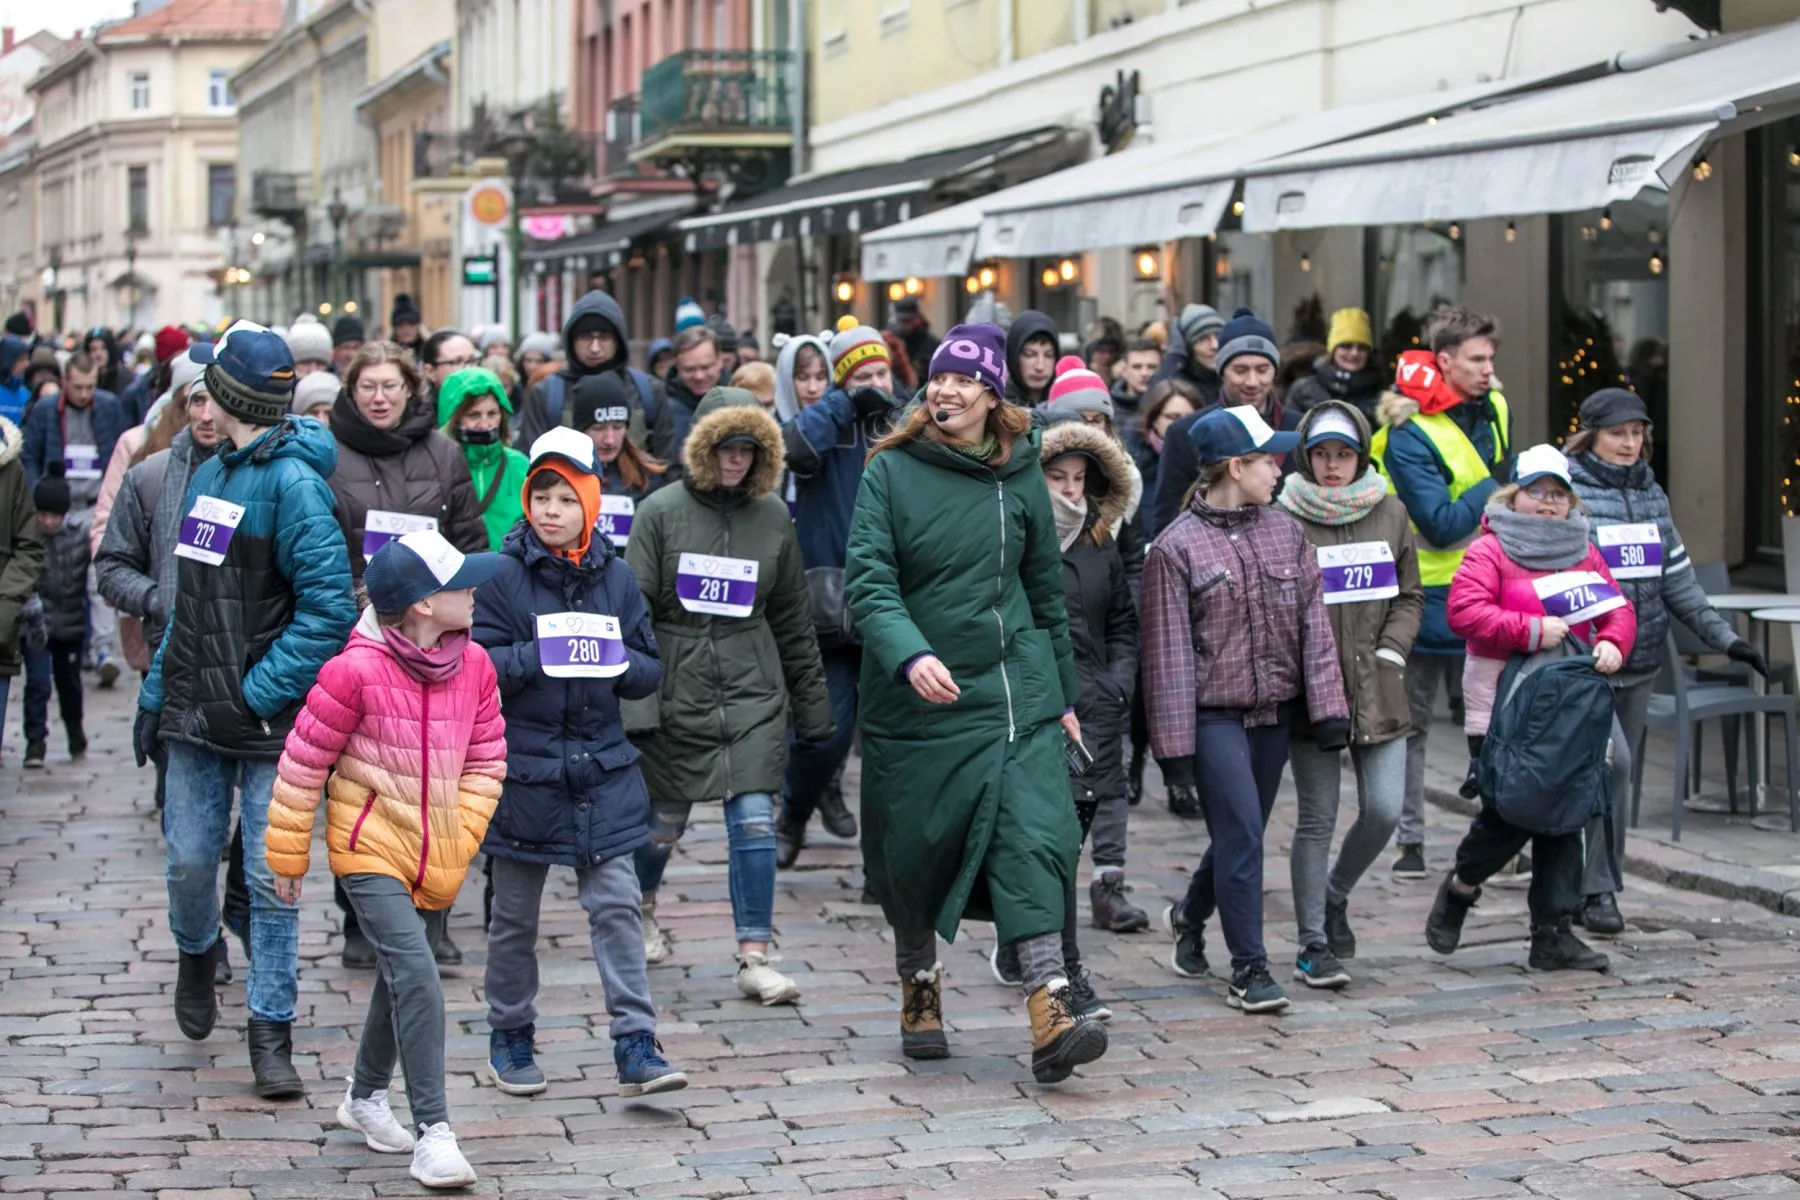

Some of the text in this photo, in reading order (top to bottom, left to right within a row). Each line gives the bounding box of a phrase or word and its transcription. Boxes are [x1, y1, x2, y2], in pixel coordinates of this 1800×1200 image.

[931, 339, 1009, 387] OL
[193, 522, 215, 548] 272
[594, 514, 615, 534] 34
[1620, 545, 1645, 566] 580
[1343, 565, 1373, 589] 279
[698, 578, 729, 602] 281
[1564, 585, 1597, 612] 274
[567, 638, 600, 663] 280
